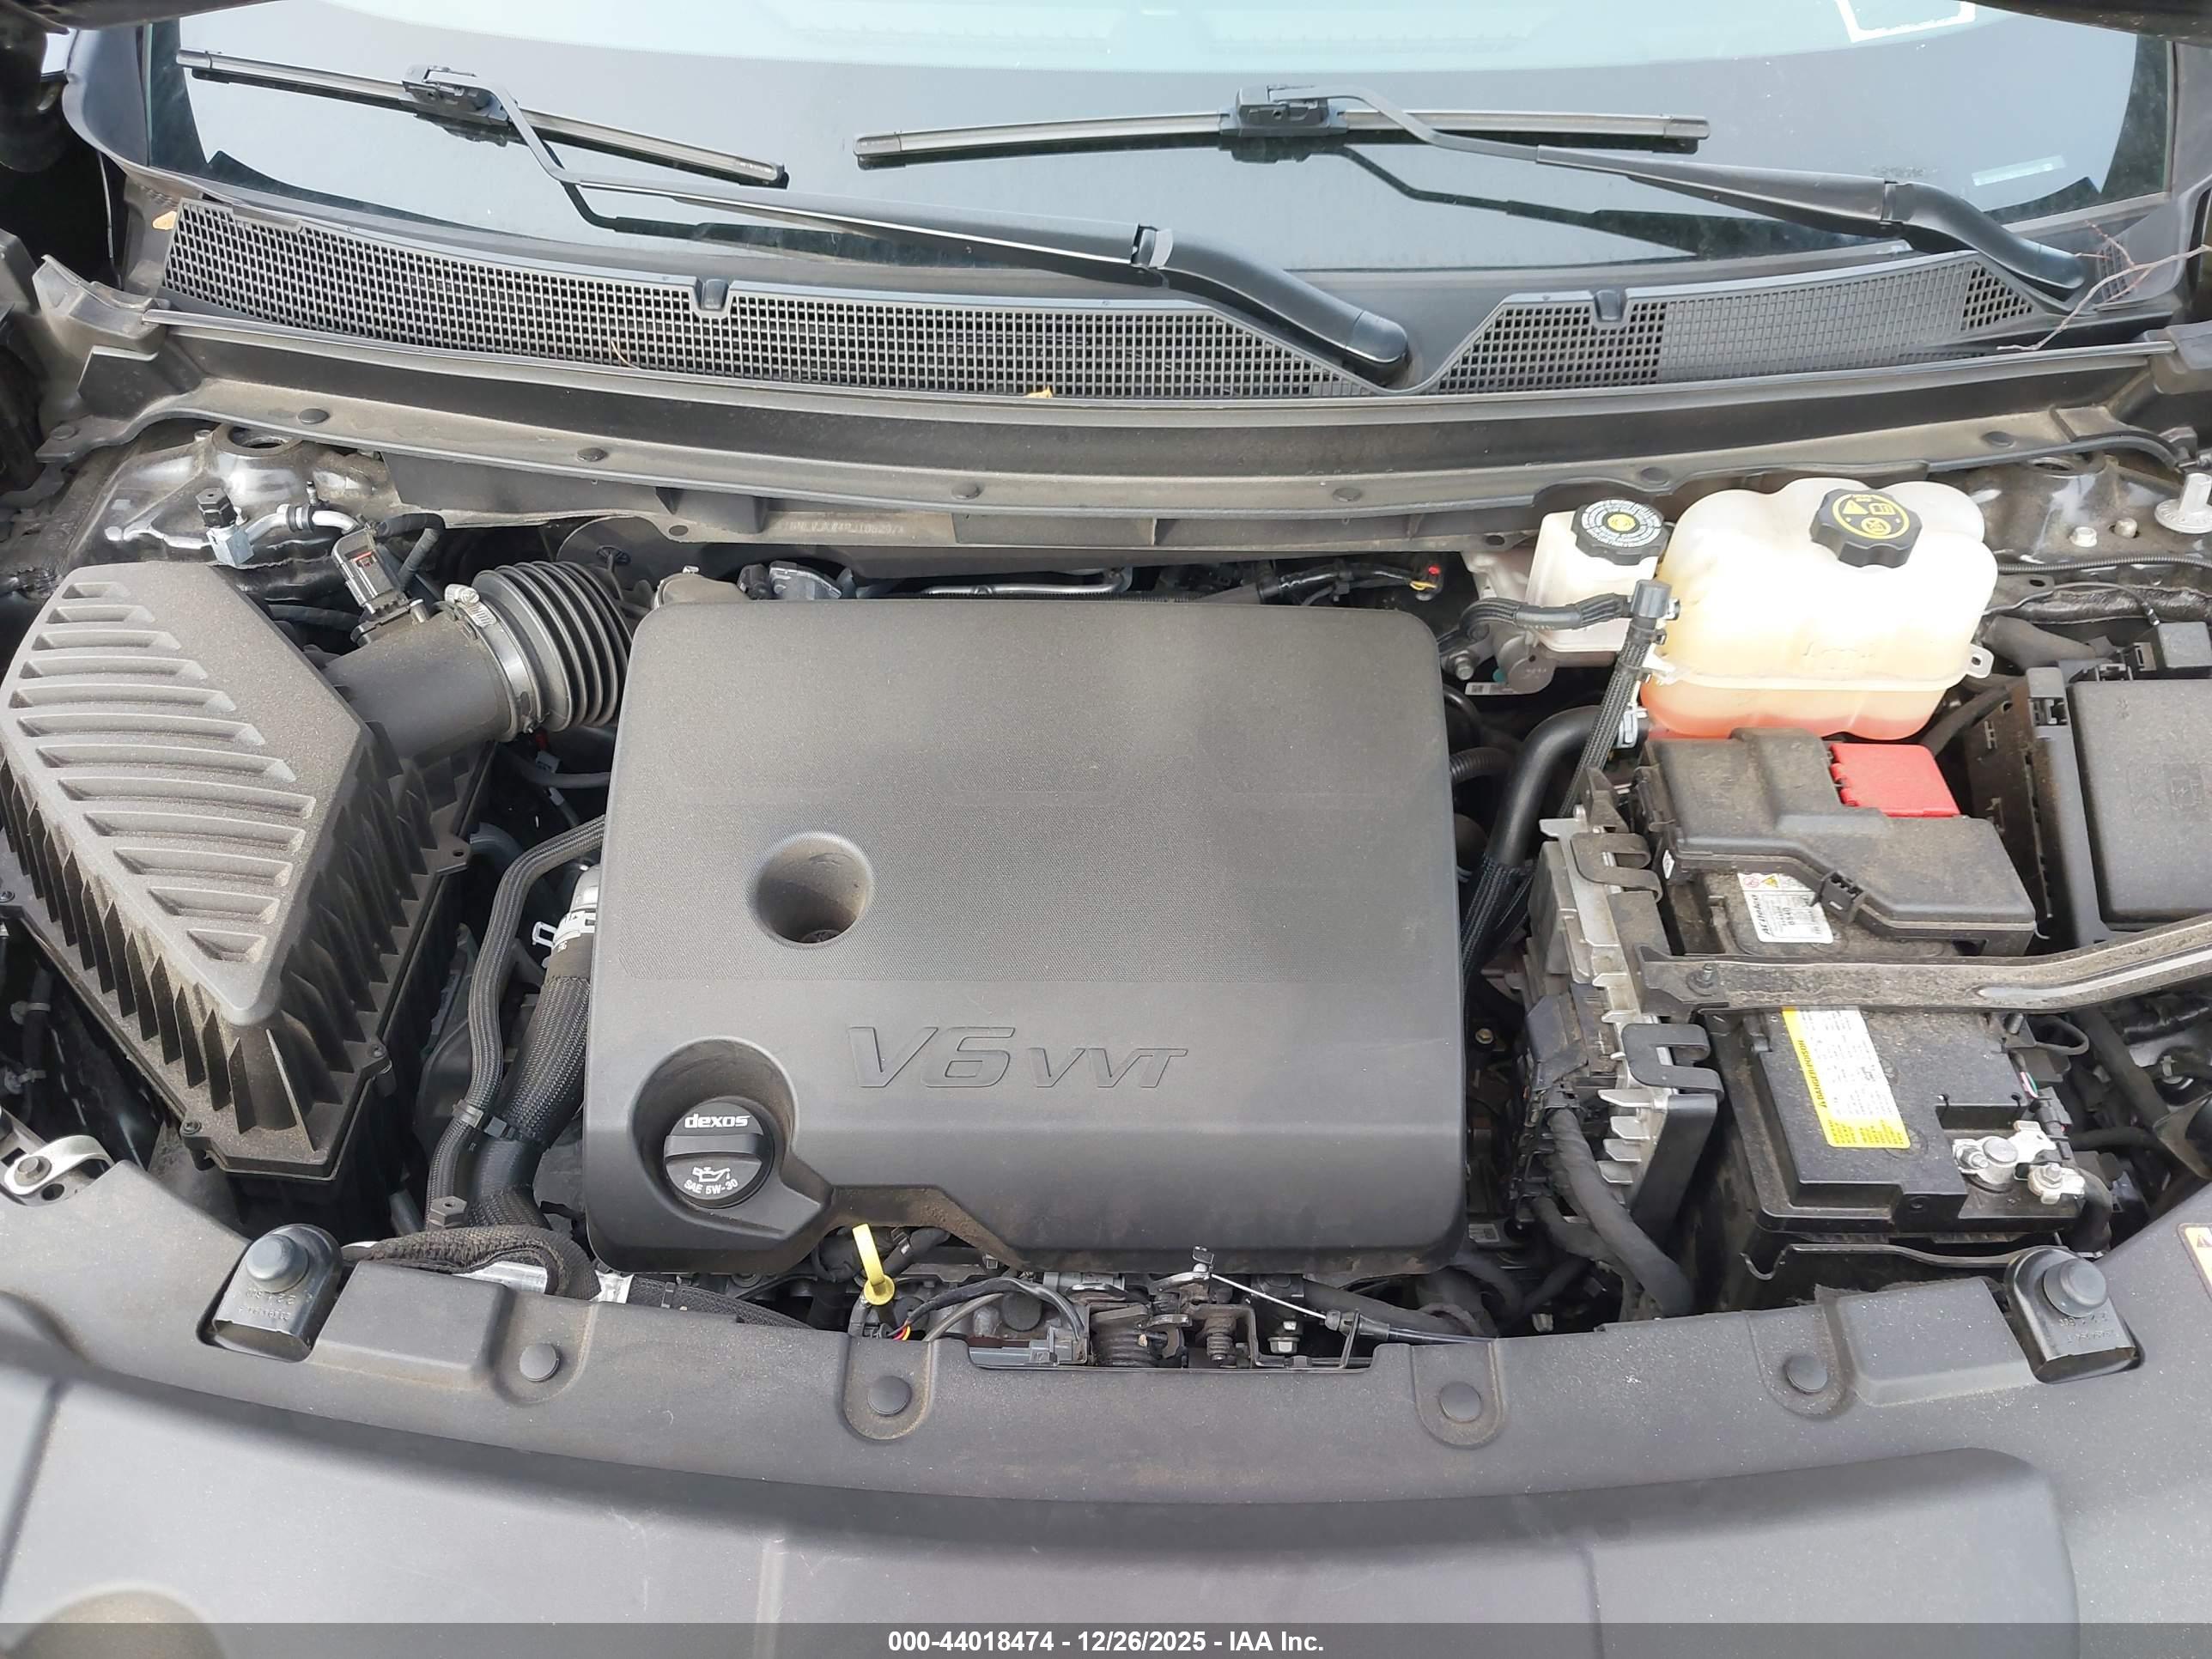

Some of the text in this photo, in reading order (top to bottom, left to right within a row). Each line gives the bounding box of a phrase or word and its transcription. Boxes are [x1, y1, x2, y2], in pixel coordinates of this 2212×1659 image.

[848, 1026, 1188, 1088] V6 VVT
[684, 1113, 750, 1128] dexos
[684, 1178, 738, 1194] SAE 5W-30
